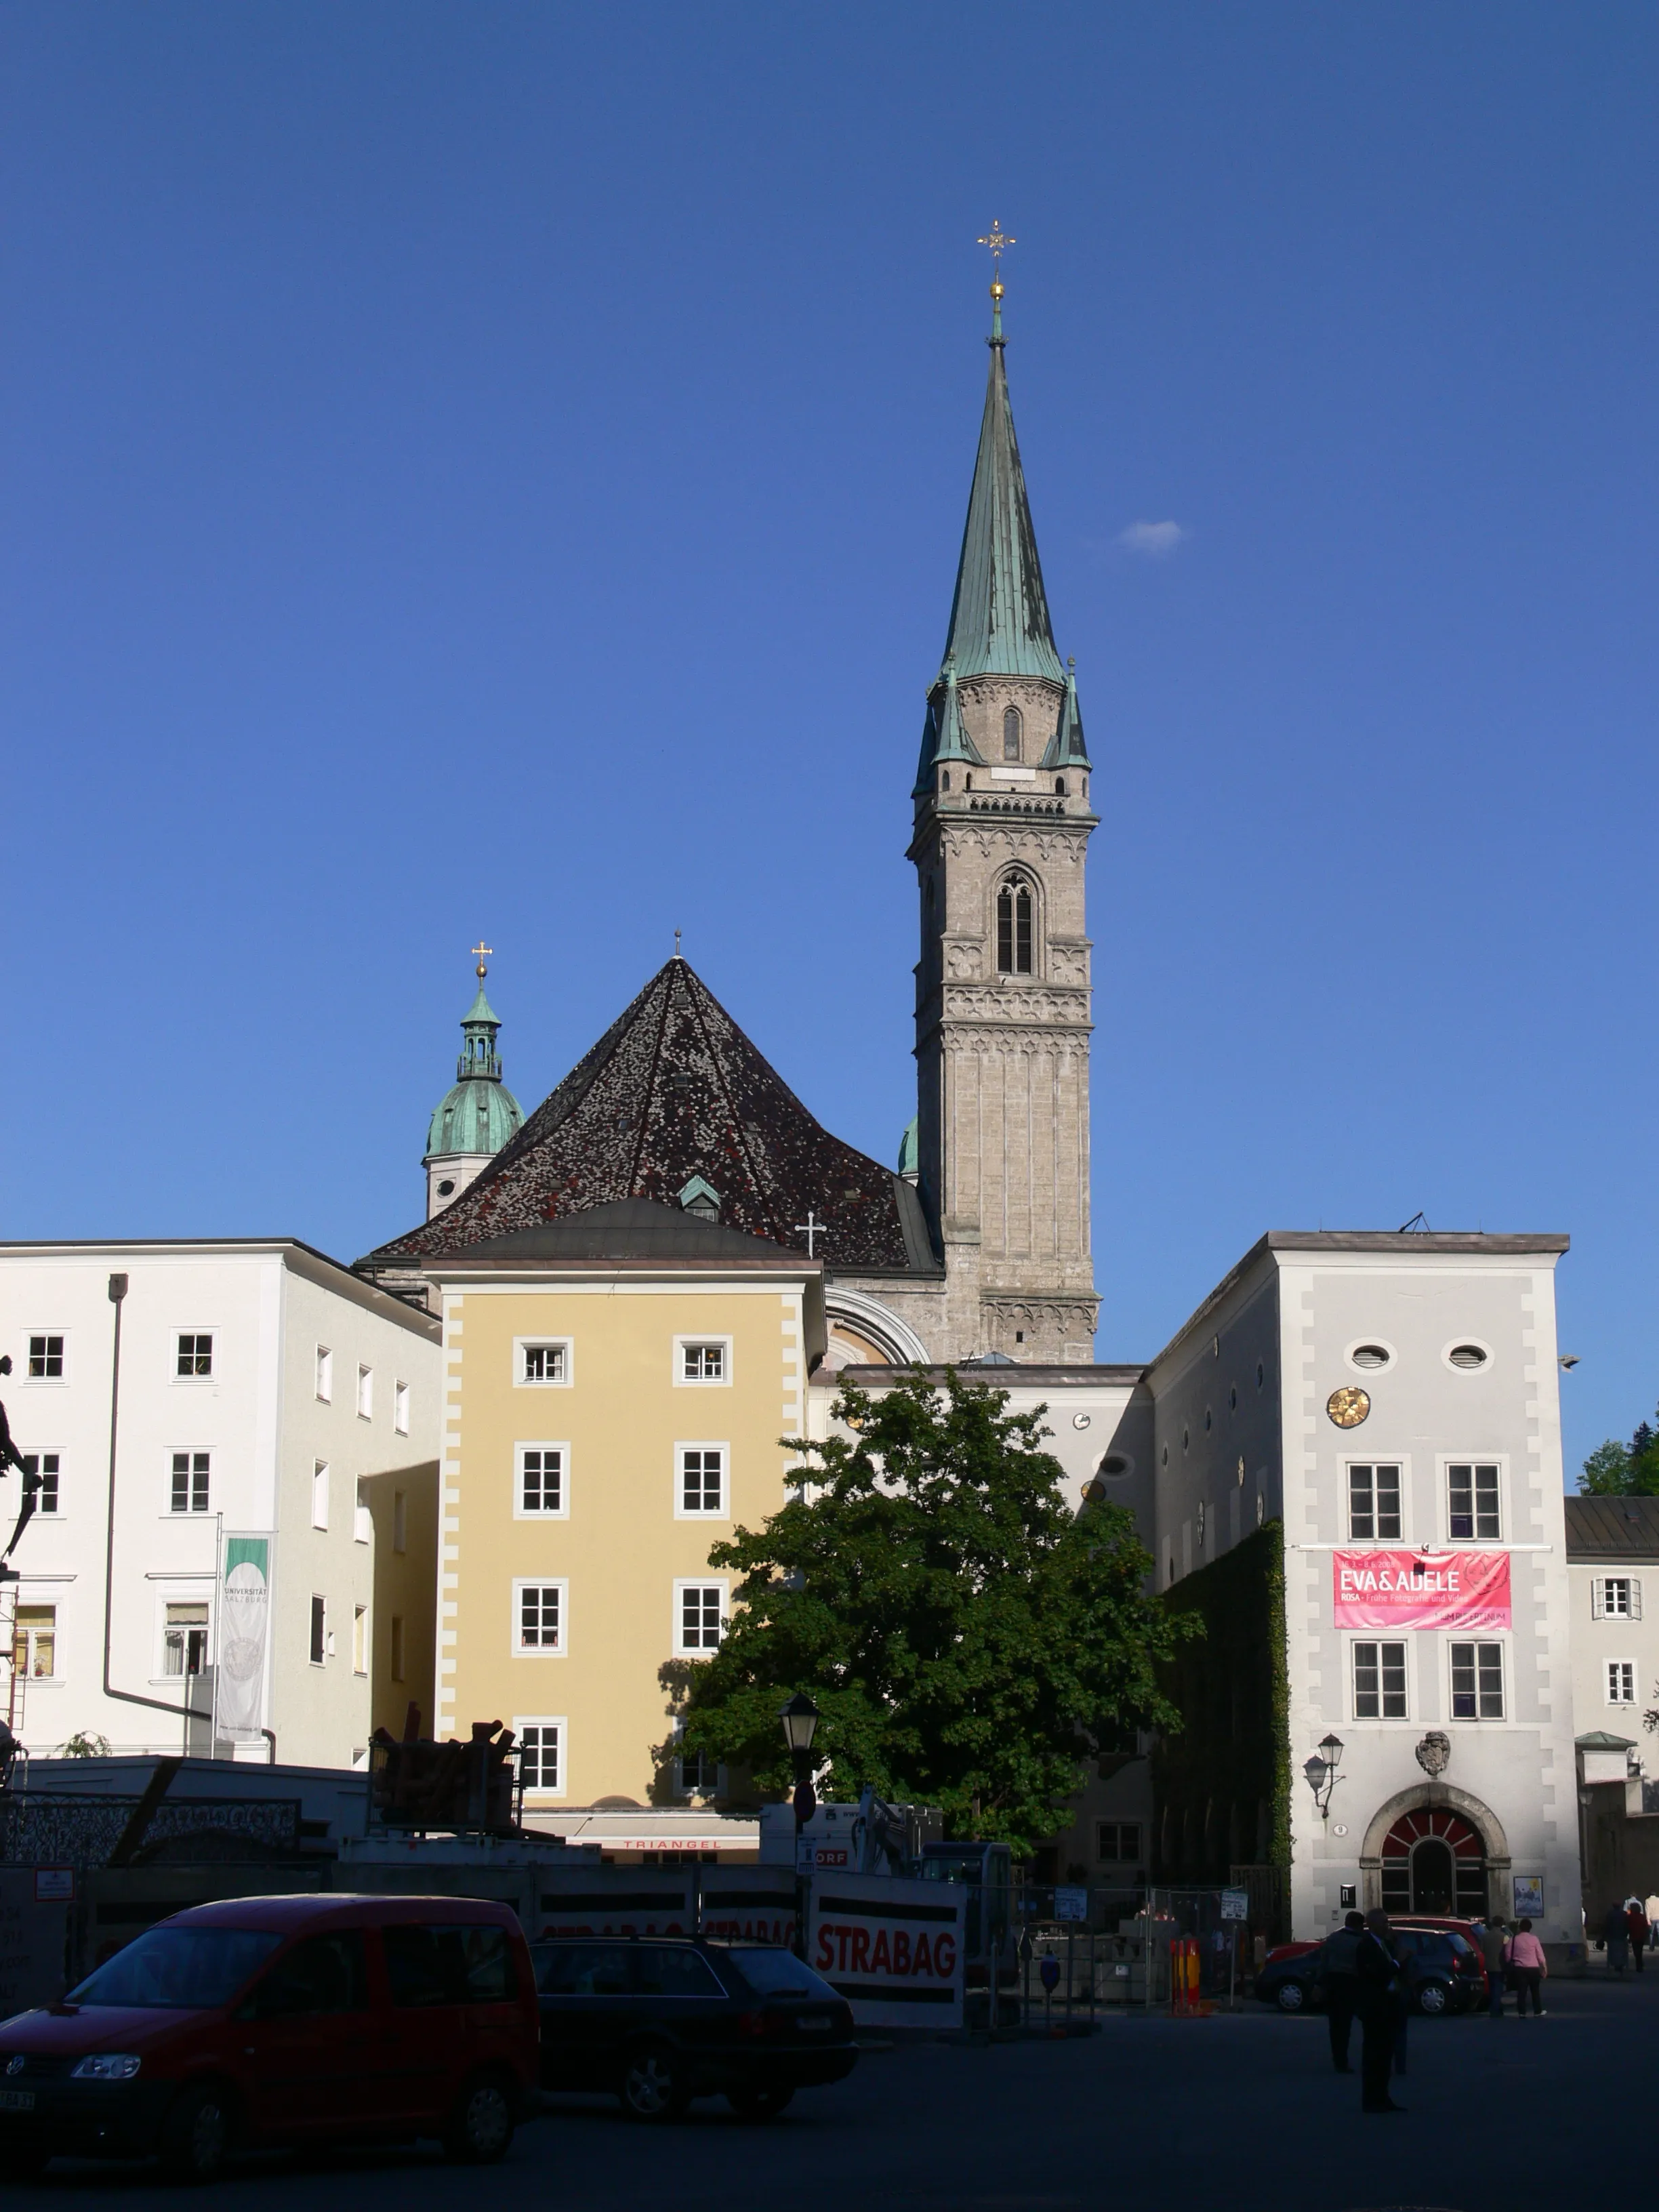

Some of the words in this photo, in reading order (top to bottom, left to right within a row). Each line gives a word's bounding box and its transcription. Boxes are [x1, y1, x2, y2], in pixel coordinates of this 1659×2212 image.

[224, 1587, 267, 1595] UNIVERSITÄT
[224, 1595, 268, 1603] SALZBURG
[1341, 1593, 1361, 1601] ROSA
[1366, 1593, 1388, 1602] Frühe
[1389, 1593, 1429, 1604] Fotografie
[1431, 1595, 1446, 1603] und
[1447, 1594, 1469, 1603] Video
[1338, 1826, 1343, 1834] 9
[623, 1841, 722, 1849] TRIANGEL
[816, 1853, 846, 1863] ORF
[815, 1923, 956, 1978] STRABAG
